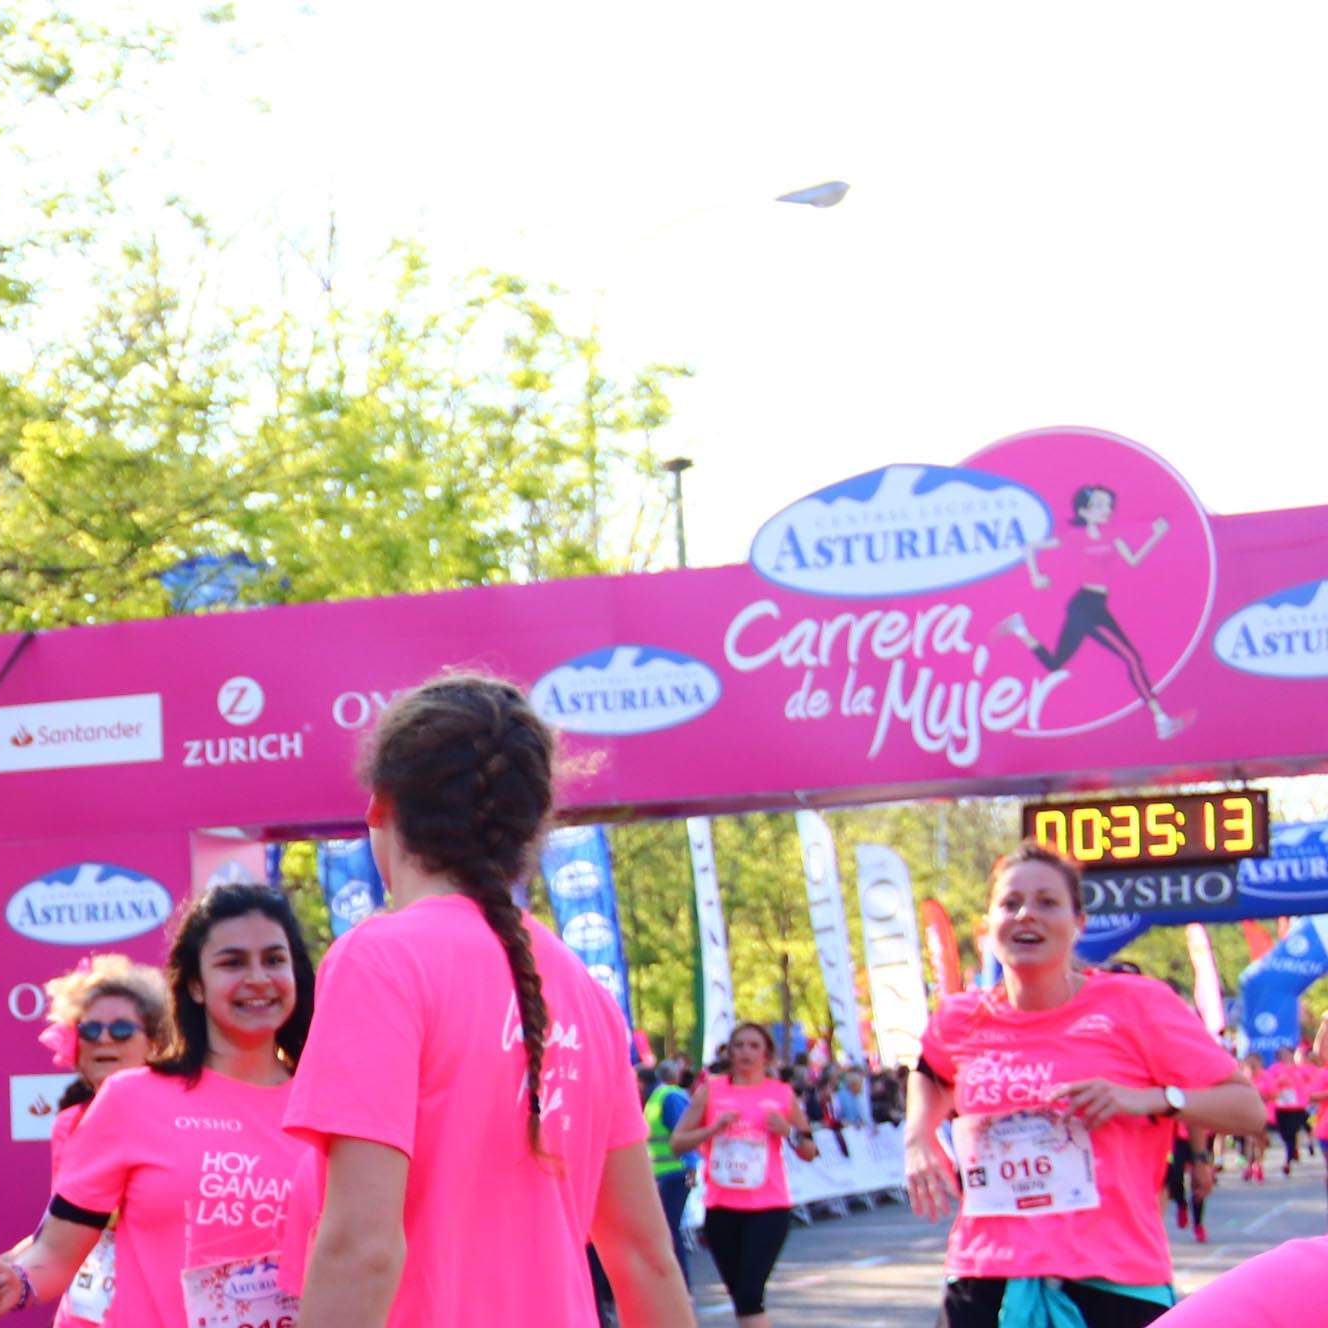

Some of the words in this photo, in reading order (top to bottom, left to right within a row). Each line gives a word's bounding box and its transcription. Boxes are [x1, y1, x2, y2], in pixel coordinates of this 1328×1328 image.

[772, 516, 1027, 572] ASTURIANA
[724, 599, 974, 672] Carrera
[545, 682, 707, 716] ASTURIANA
[784, 670, 832, 719] de
[840, 666, 877, 716] la
[866, 645, 1071, 767] Mujer
[37, 720, 144, 747] Santander
[182, 731, 303, 767] ZURICH
[18, 898, 159, 927] ASTURIANA
[174, 1116, 243, 1132] OYSHO
[201, 1151, 260, 1175] HOY
[1000, 1155, 1052, 1180] 016
[196, 1200, 245, 1226] LAS
